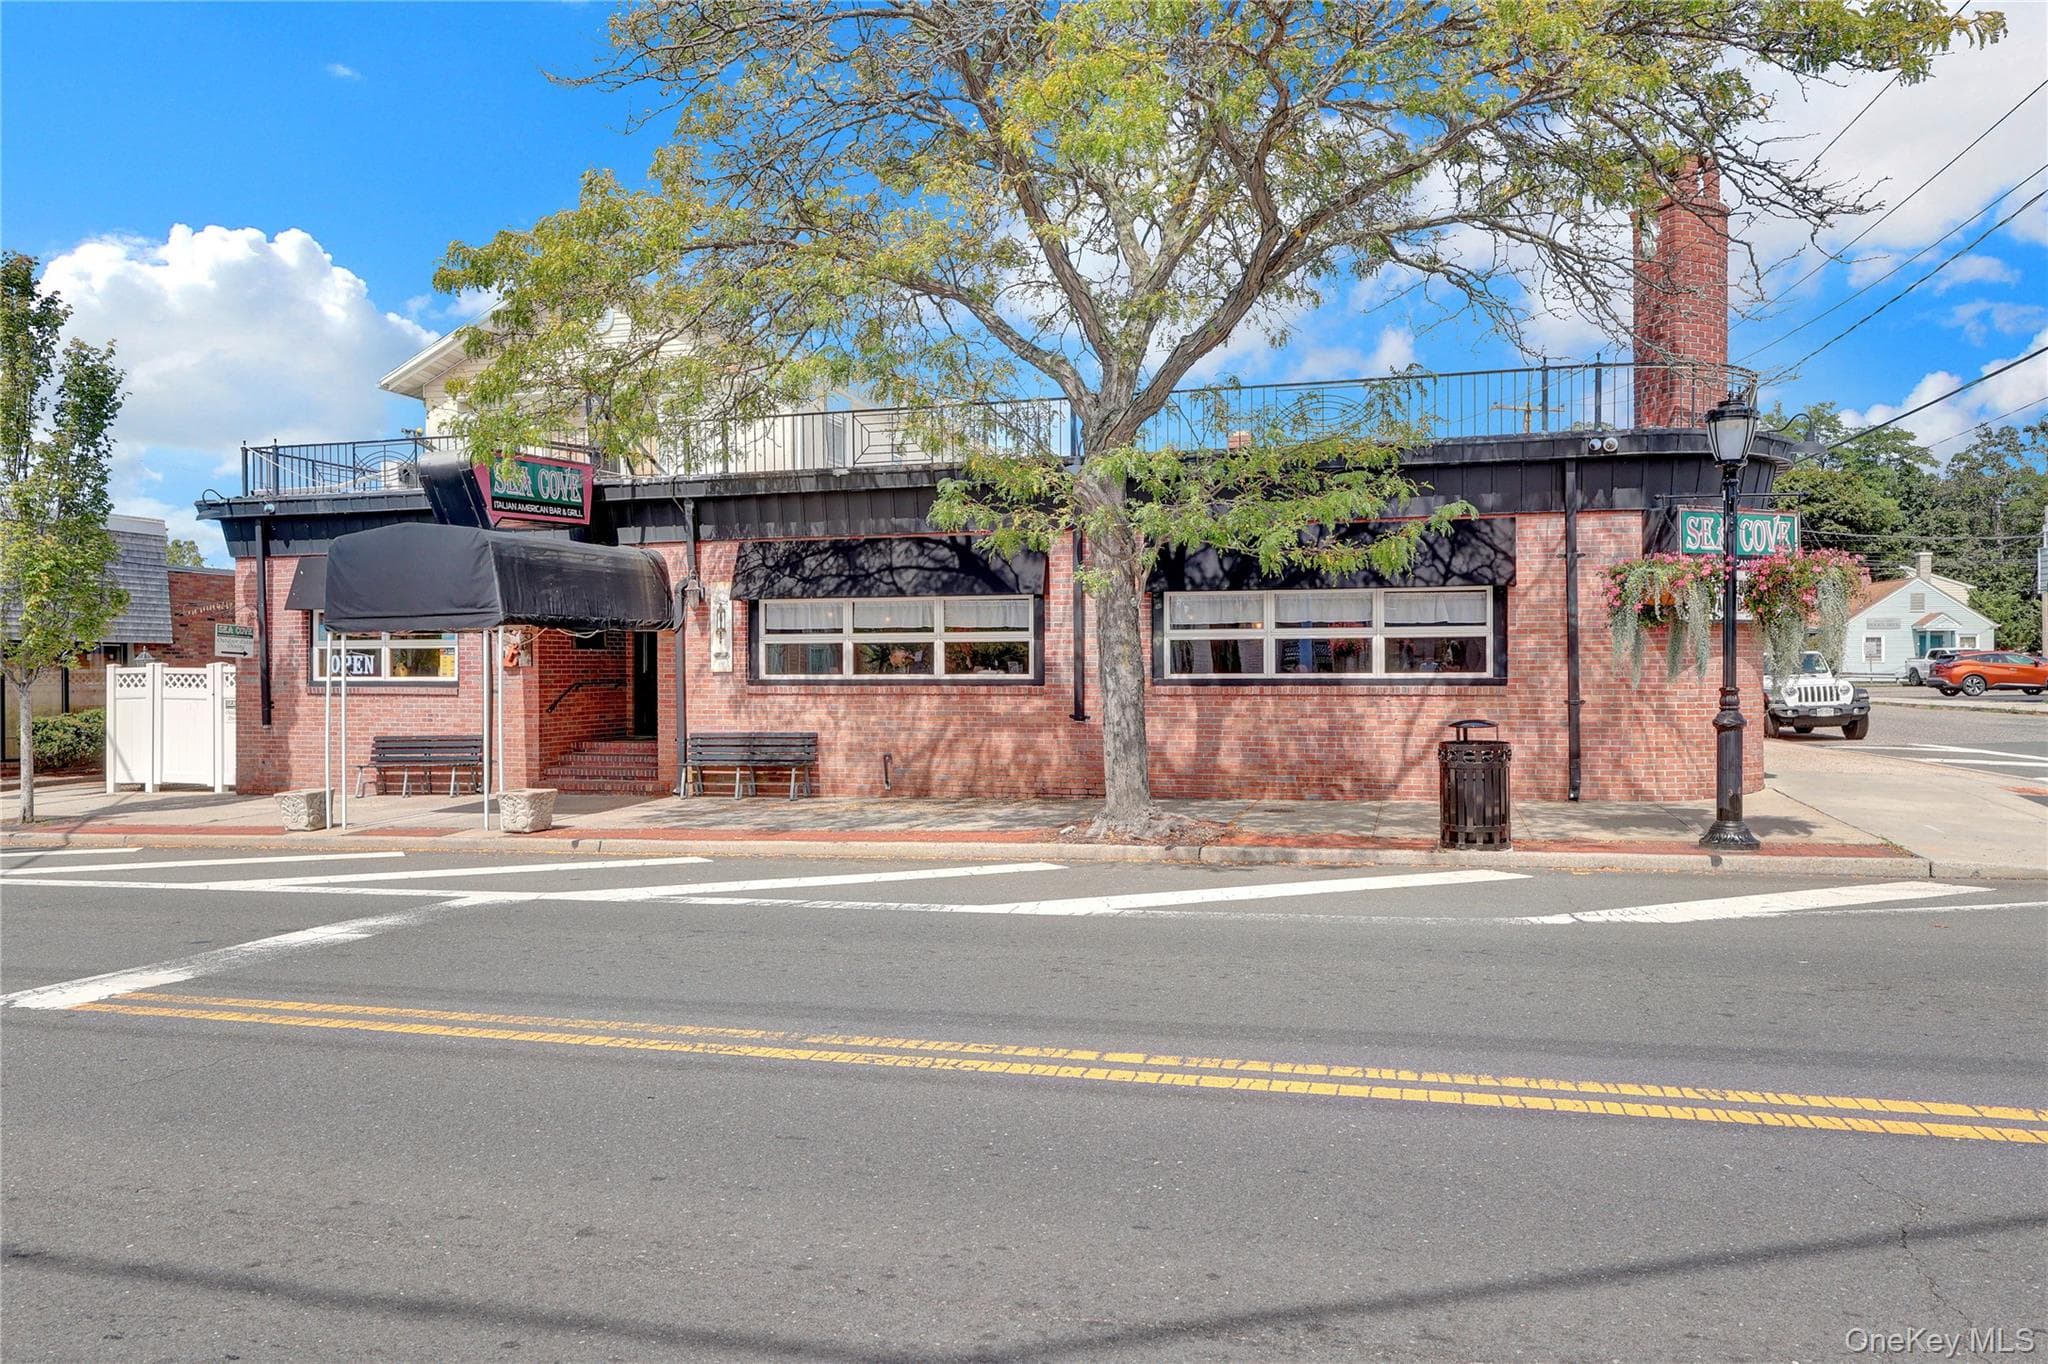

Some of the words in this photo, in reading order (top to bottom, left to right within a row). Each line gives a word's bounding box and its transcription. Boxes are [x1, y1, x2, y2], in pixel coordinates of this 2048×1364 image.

[537, 466, 582, 503] COVE
[494, 501, 516, 511] ITALIAN
[517, 504, 548, 514] AMERICAN
[549, 507, 561, 515] BAR
[562, 508, 567, 516] &
[567, 509, 583, 517] GRILL
[1740, 515, 1793, 553] COVE
[331, 655, 375, 675] OPEN
